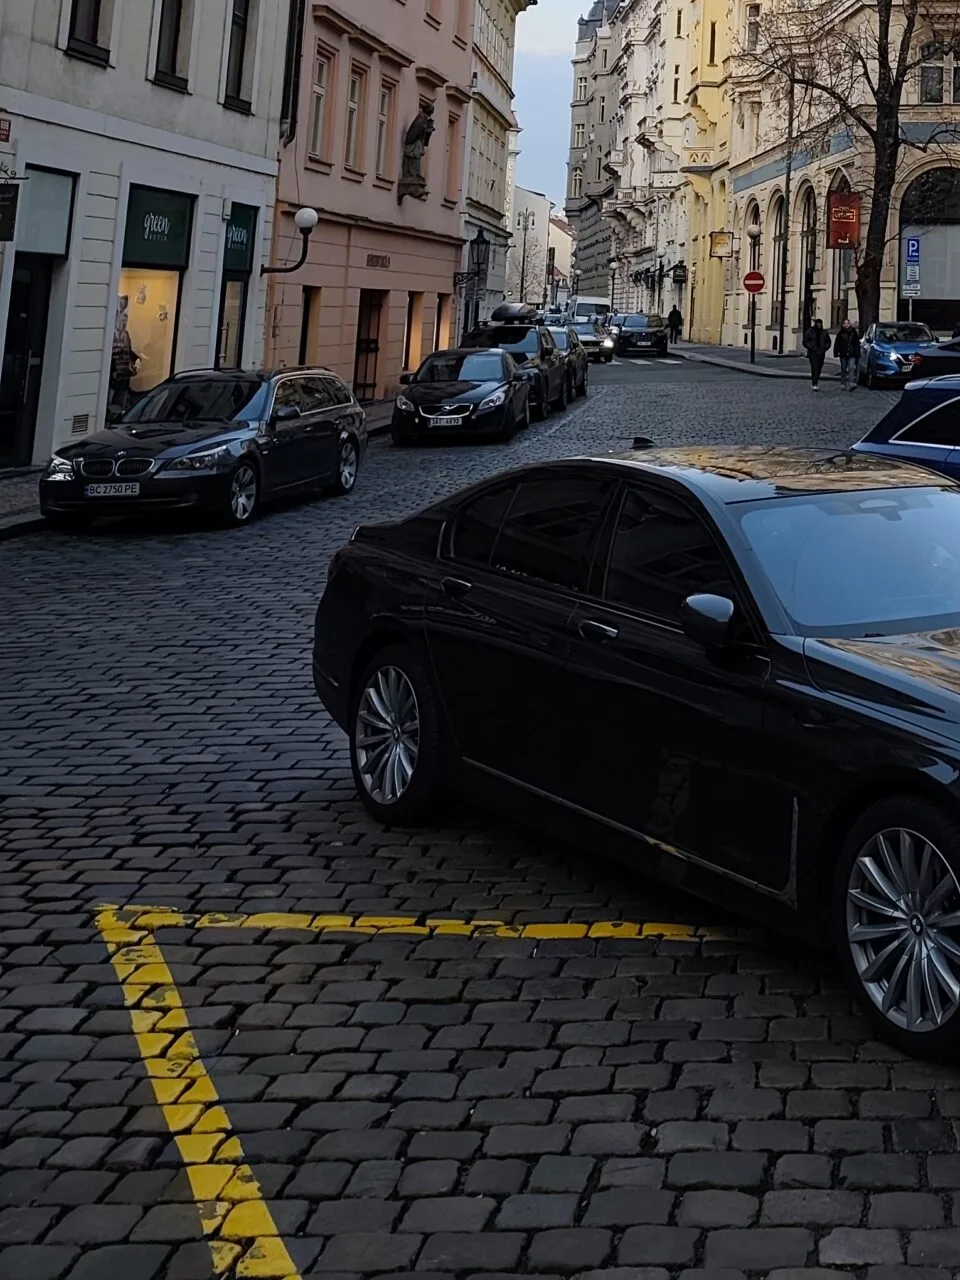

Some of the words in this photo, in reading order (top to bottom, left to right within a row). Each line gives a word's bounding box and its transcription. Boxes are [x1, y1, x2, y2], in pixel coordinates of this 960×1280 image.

[144, 212, 171, 240] green
[227, 225, 249, 249] green
[909, 240, 918, 256] P
[89, 485, 102, 495] BC
[103, 484, 123, 494] 2750
[124, 483, 137, 494] PE
